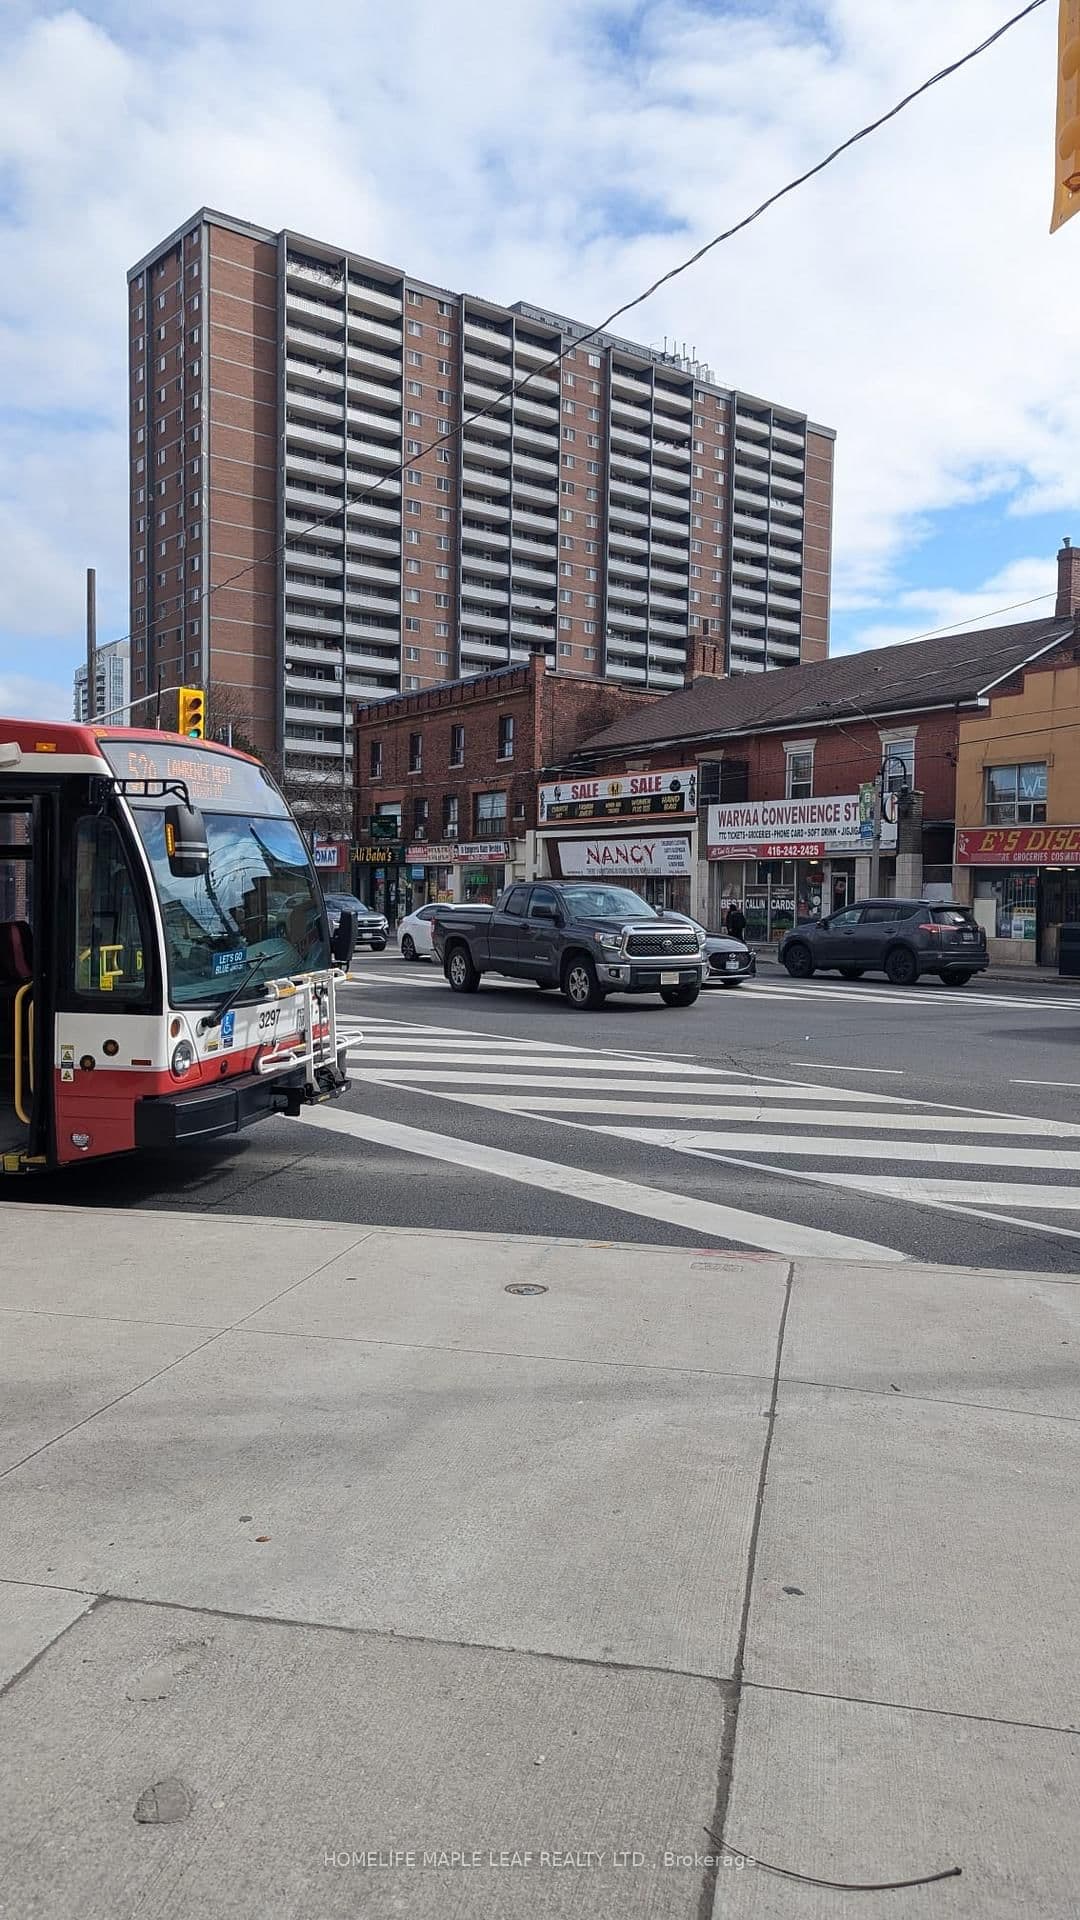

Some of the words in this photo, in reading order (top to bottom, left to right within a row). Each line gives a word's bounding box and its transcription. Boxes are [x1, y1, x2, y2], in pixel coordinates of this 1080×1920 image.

[571, 783, 599, 800] SALE
[630, 776, 662, 794] SALE
[718, 809, 759, 828] WARYAA
[762, 803, 841, 826] CONVENIENCE
[355, 847, 365, 862] Ali
[366, 847, 392, 862] Baba's
[586, 843, 656, 865] NANCY
[767, 845, 819, 857] 416-242-2425
[1013, 852, 1047, 861] GROCERIES
[770, 899, 796, 910] CARDS
[219, 953, 234, 964] LET'S
[234, 951, 243, 961] GO
[259, 1008, 281, 1029] 3297
